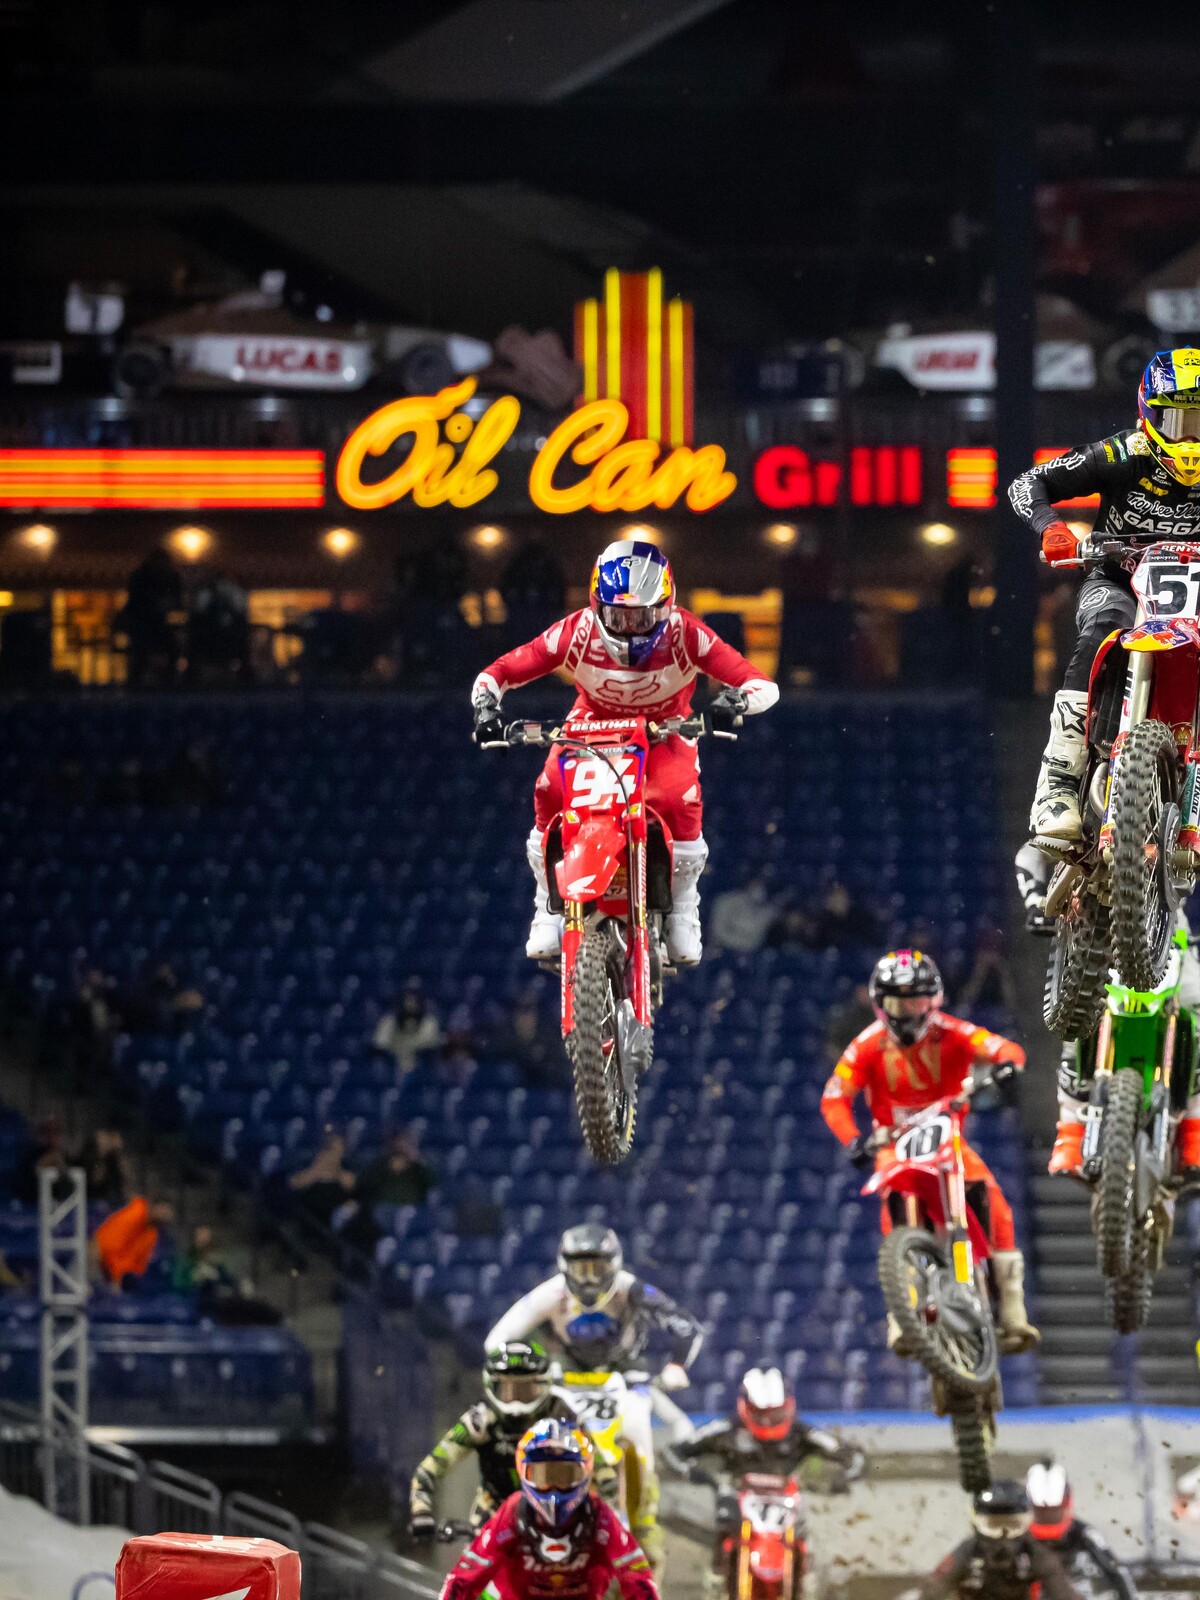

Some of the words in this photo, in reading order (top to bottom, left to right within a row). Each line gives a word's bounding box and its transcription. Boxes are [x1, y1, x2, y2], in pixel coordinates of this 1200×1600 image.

[235, 345, 342, 374] LUCAS
[336, 375, 521, 510] Oil
[529, 398, 737, 514] Can
[754, 445, 922, 509] Grill
[1126, 490, 1152, 515] Troy
[1150, 500, 1174, 518] Lee
[573, 615, 591, 651] FOX
[570, 720, 638, 731] RENTHAL
[570, 758, 637, 808] 94
[574, 1398, 617, 1419] 28
